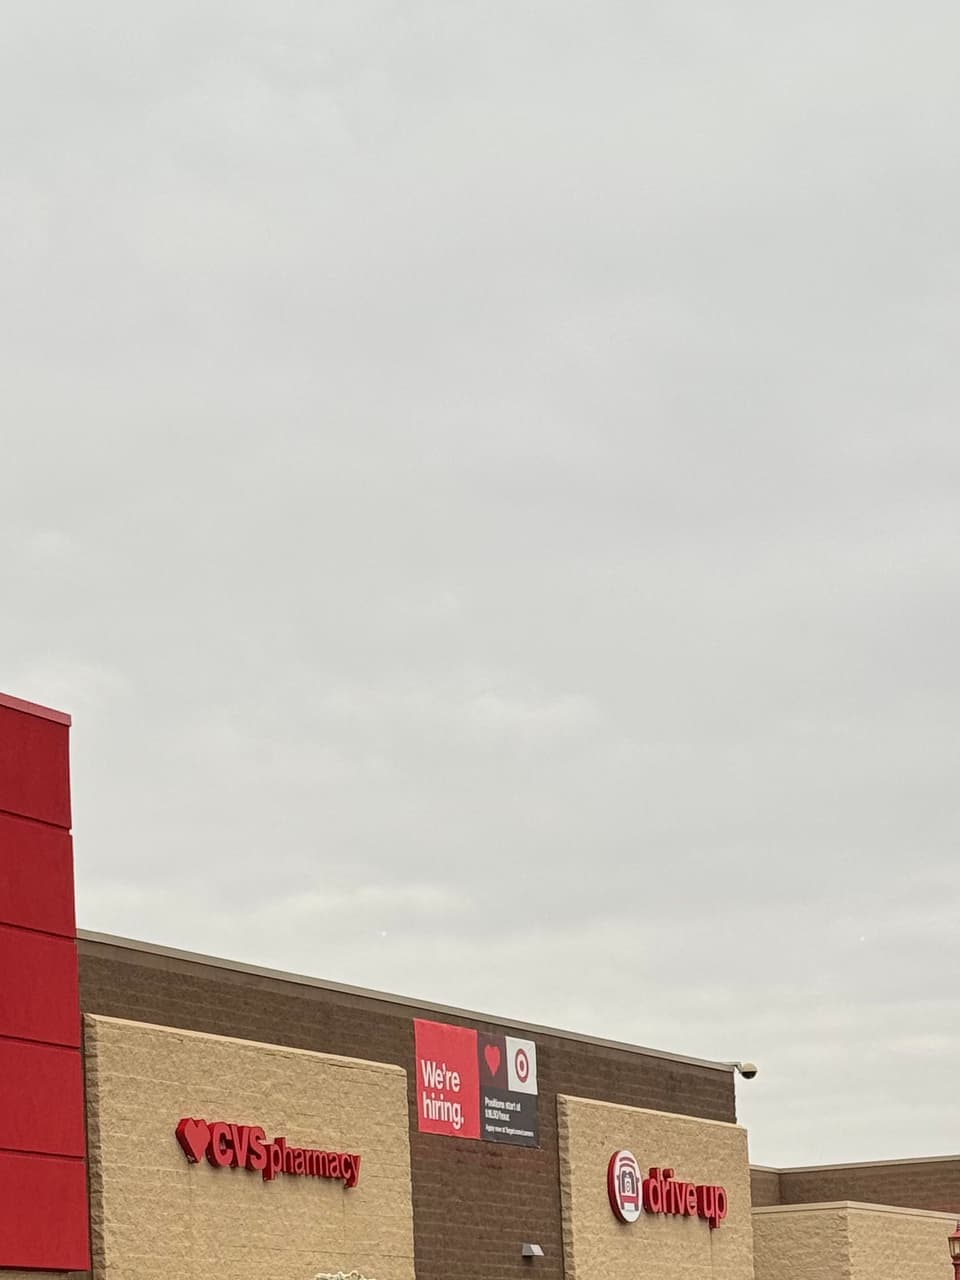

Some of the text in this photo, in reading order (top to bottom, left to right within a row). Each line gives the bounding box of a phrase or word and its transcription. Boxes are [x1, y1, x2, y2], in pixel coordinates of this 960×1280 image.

[421, 1059, 460, 1093] We're
[423, 1091, 465, 1130] hiring.
[208, 1122, 361, 1189] CVS pharmacy
[643, 1167, 728, 1229] drive up
